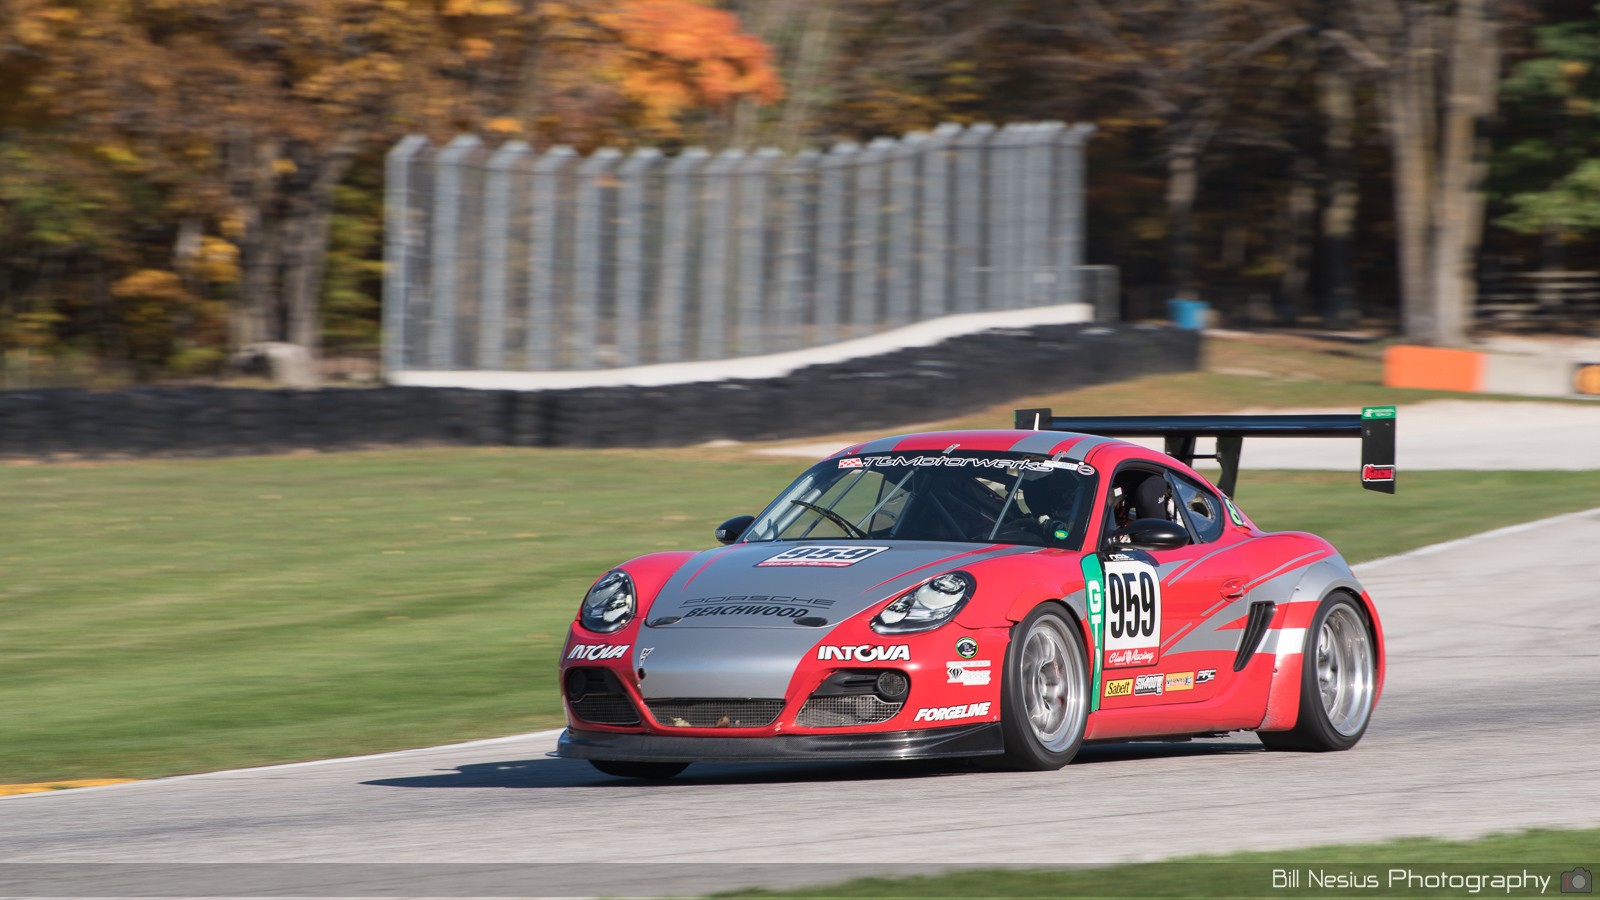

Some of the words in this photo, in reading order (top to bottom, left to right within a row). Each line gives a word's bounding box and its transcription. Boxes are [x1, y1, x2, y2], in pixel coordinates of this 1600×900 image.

[777, 547, 878, 560] 959
[683, 595, 836, 606] PORSCHE
[1108, 571, 1156, 639] 959
[684, 605, 809, 618] BEACHWOOD
[567, 643, 631, 661] INTOVA
[817, 644, 911, 662] INTOVA
[1108, 650, 1127, 663] Club
[1131, 649, 1154, 663] Racing
[1108, 682, 1130, 695] Sabelt
[913, 701, 992, 721] FORGELINE
